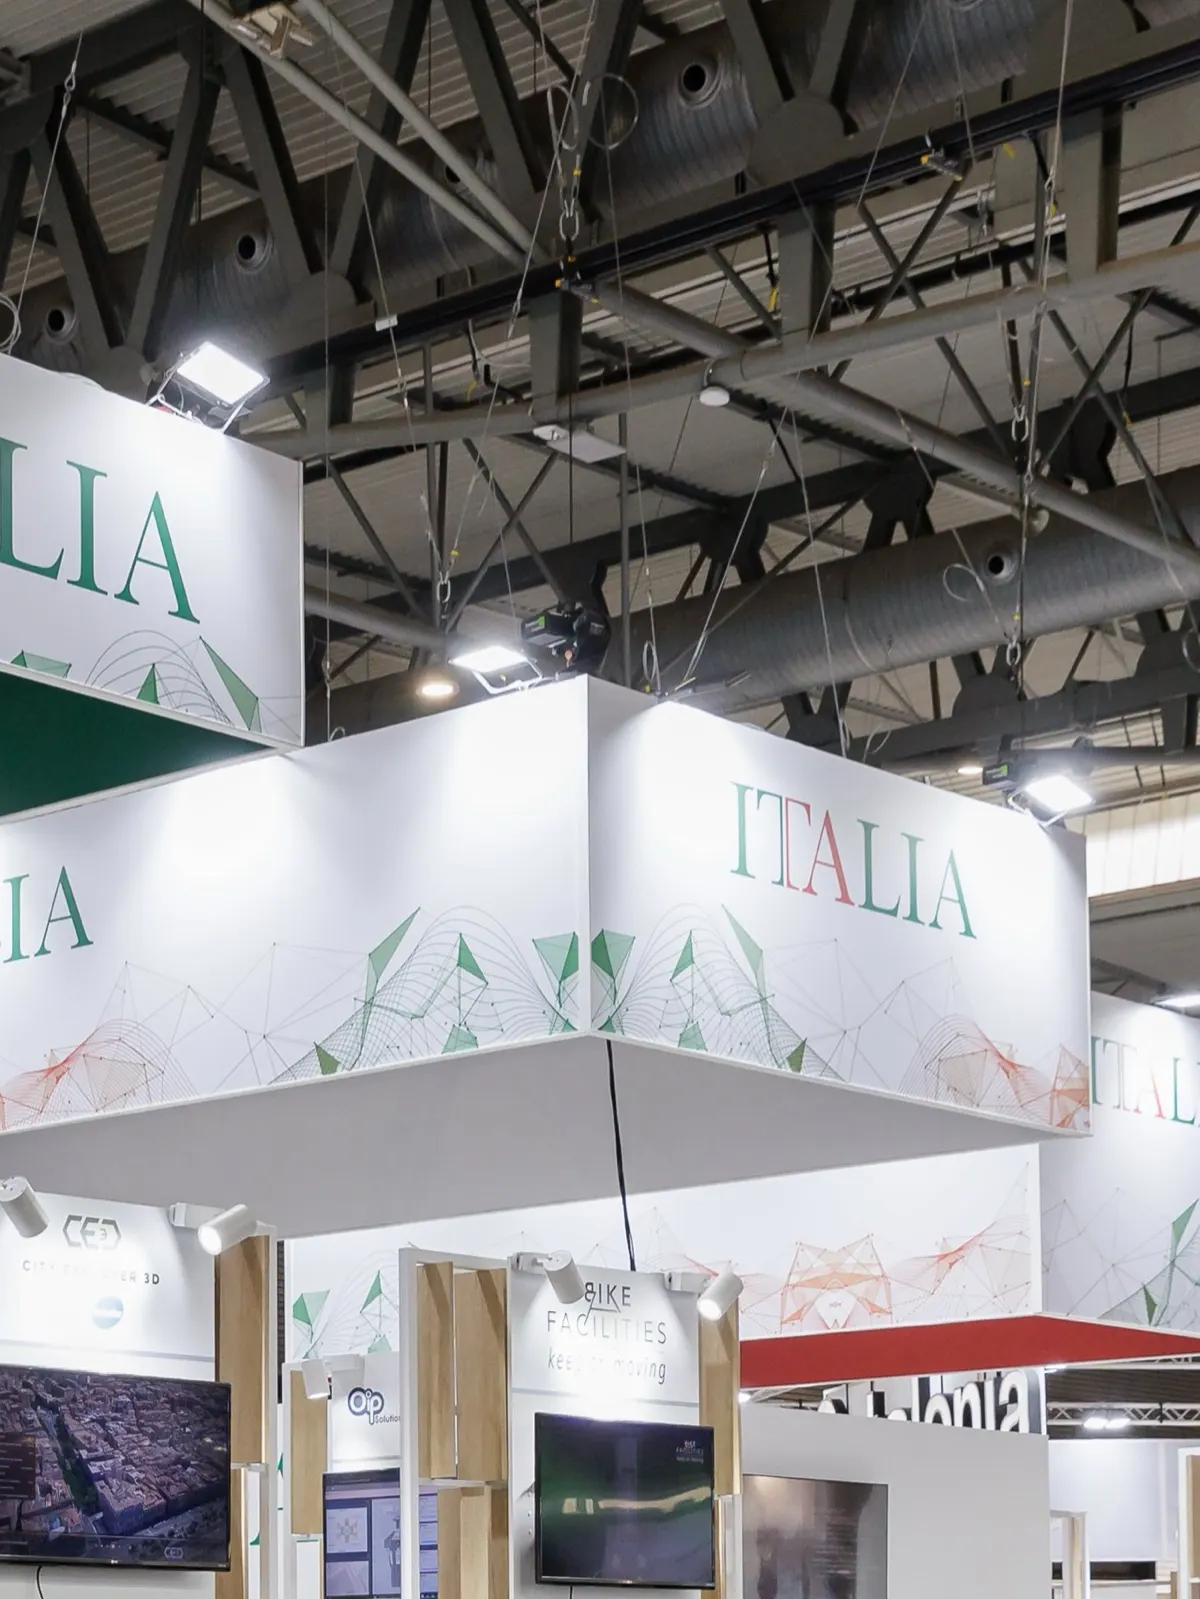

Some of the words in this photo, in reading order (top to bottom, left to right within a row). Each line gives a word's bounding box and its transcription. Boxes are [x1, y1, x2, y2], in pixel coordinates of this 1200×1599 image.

[729, 781, 978, 939] ITALIA
[1091, 1036, 1200, 1127] ITAL
[144, 1272, 160, 1285] 3D
[584, 1281, 632, 1311] BIKE
[546, 1310, 668, 1345] FACILITIES
